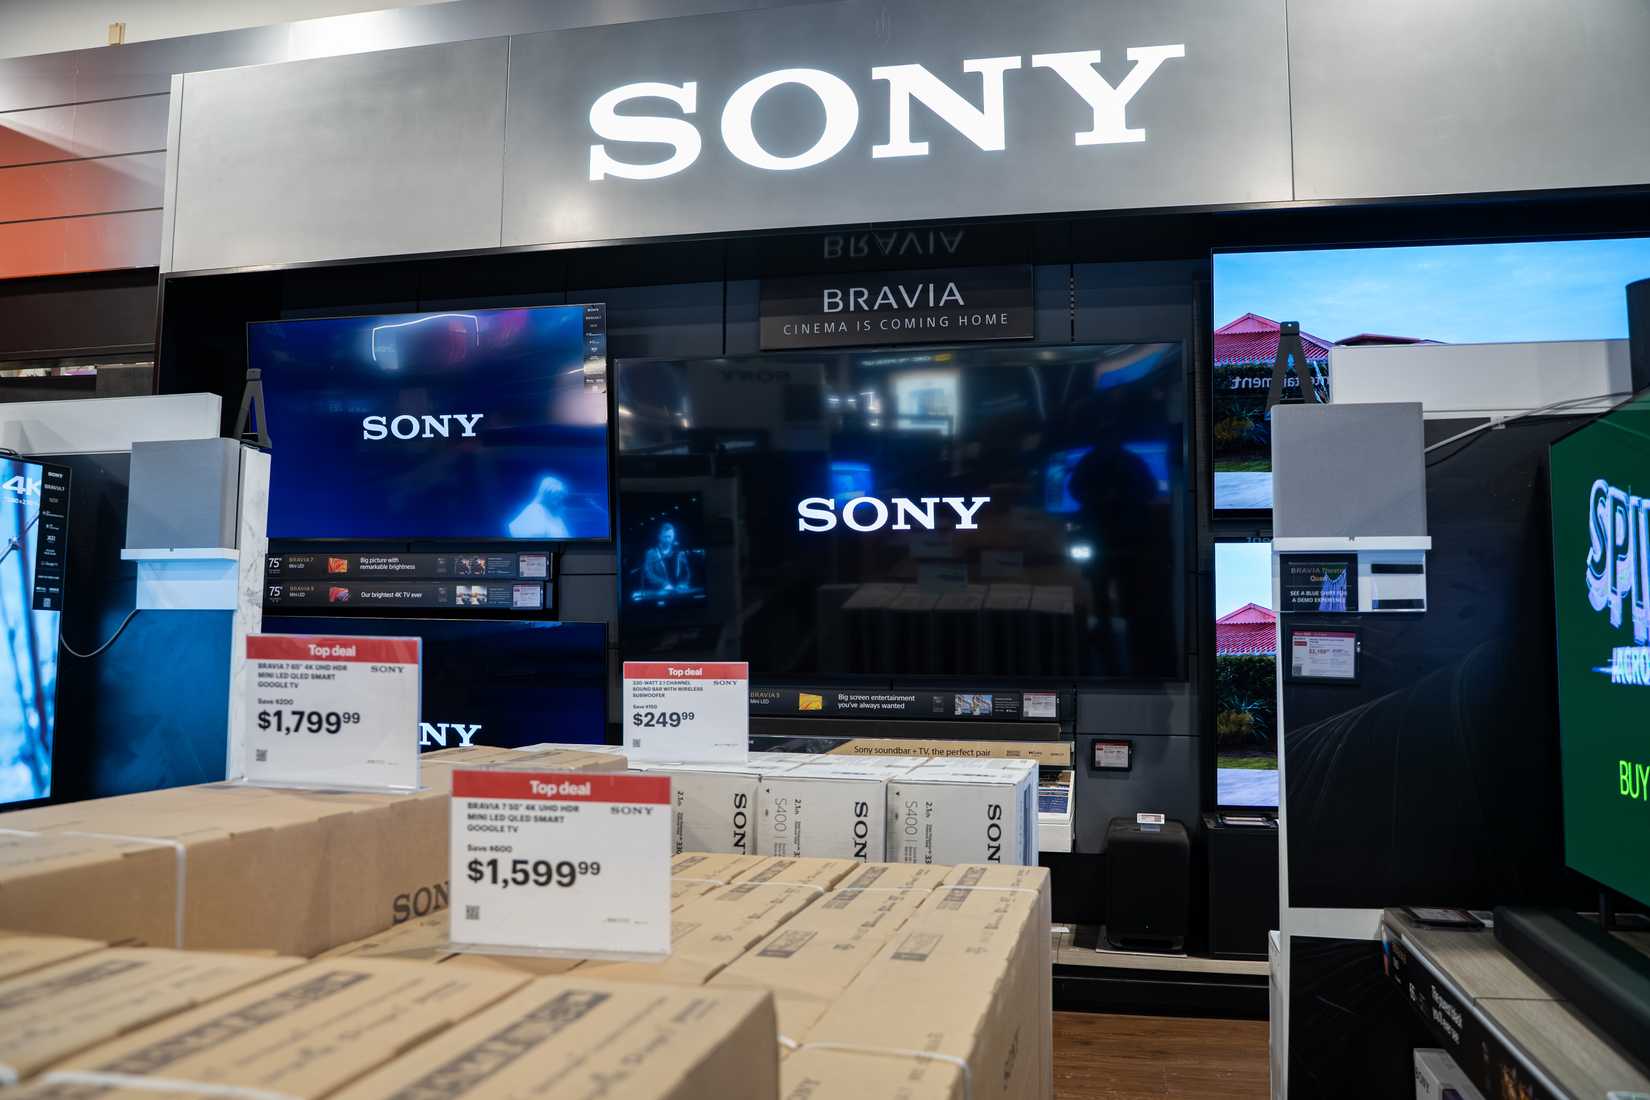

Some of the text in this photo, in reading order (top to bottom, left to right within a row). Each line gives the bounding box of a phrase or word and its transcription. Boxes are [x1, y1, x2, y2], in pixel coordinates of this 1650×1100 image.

[588, 44, 1186, 181] SONY
[823, 282, 965, 313] BRAVIA
[783, 313, 1009, 335] CINEMA IS COMING HOME
[362, 413, 484, 440] SONY
[2, 476, 42, 496] 4K
[797, 496, 991, 532] SONY
[1586, 479, 1650, 641] SPI
[308, 644, 356, 658] Top deal
[668, 668, 703, 677] Top deal
[1610, 647, 1650, 685] ACRO
[838, 693, 848, 701] Big
[859, 702, 881, 710] always
[419, 722, 482, 747] NY
[854, 745, 873, 755] Sony
[874, 746, 911, 755] soundbar
[918, 748, 929, 756] TV,
[931, 747, 943, 755] the
[946, 747, 974, 757] perfect
[975, 748, 991, 758] pair
[530, 780, 591, 797] Top deal
[467, 802, 499, 810] BRAVIA
[538, 804, 558, 812] UHD
[467, 813, 564, 823] MINI LED QLED SMART
[610, 806, 654, 815] SONY
[774, 798, 787, 832] S400
[904, 800, 918, 836] S400
[467, 825, 519, 833] GOOGLE TV
[733, 793, 747, 855] SON
[853, 801, 869, 863] SON
[987, 804, 1002, 863] SON
[467, 844, 488, 852] Save
[393, 880, 449, 926] SON
